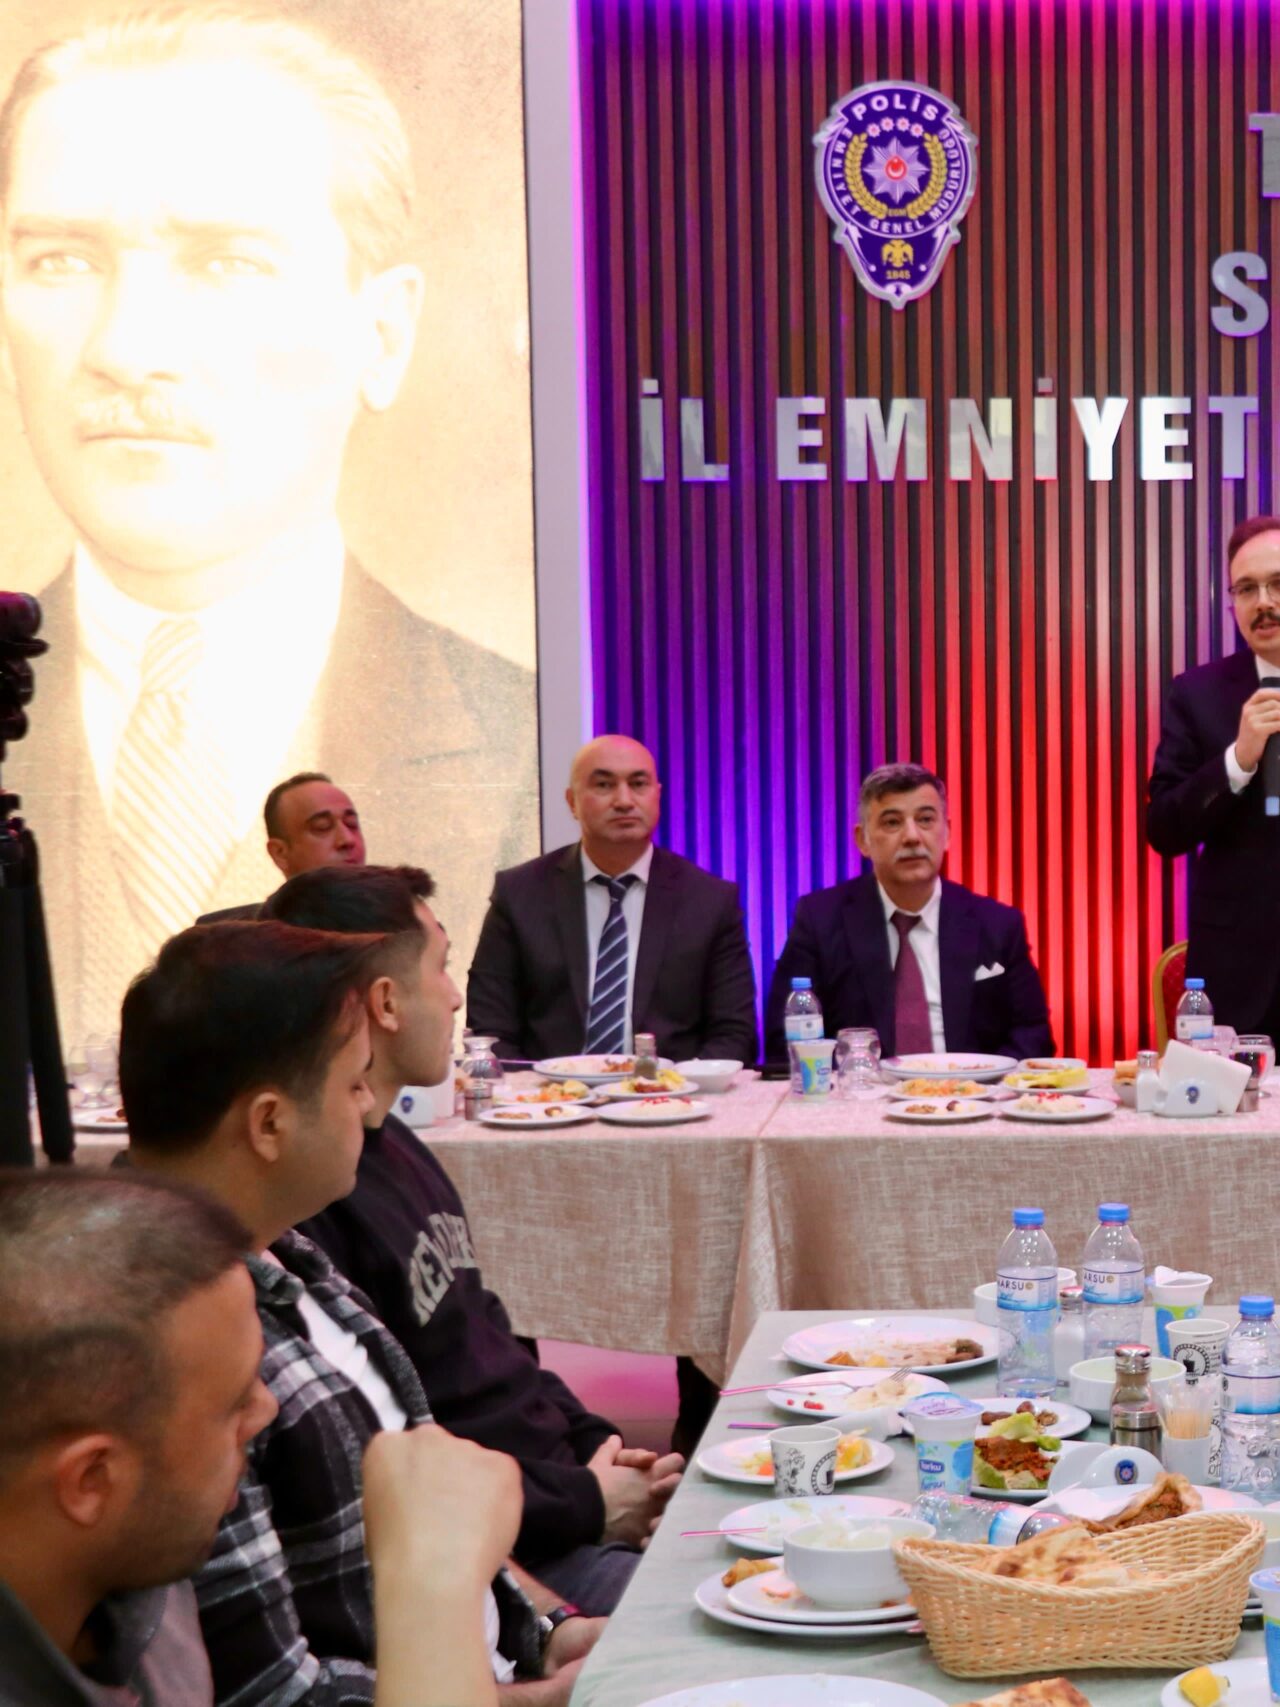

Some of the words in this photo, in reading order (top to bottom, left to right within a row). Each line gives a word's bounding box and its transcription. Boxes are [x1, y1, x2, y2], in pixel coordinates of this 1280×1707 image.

[851, 93, 939, 121] POLİS
[869, 218, 925, 234] GENEL
[639, 378, 729, 482] İL
[775, 377, 1260, 482] EMNİYET
